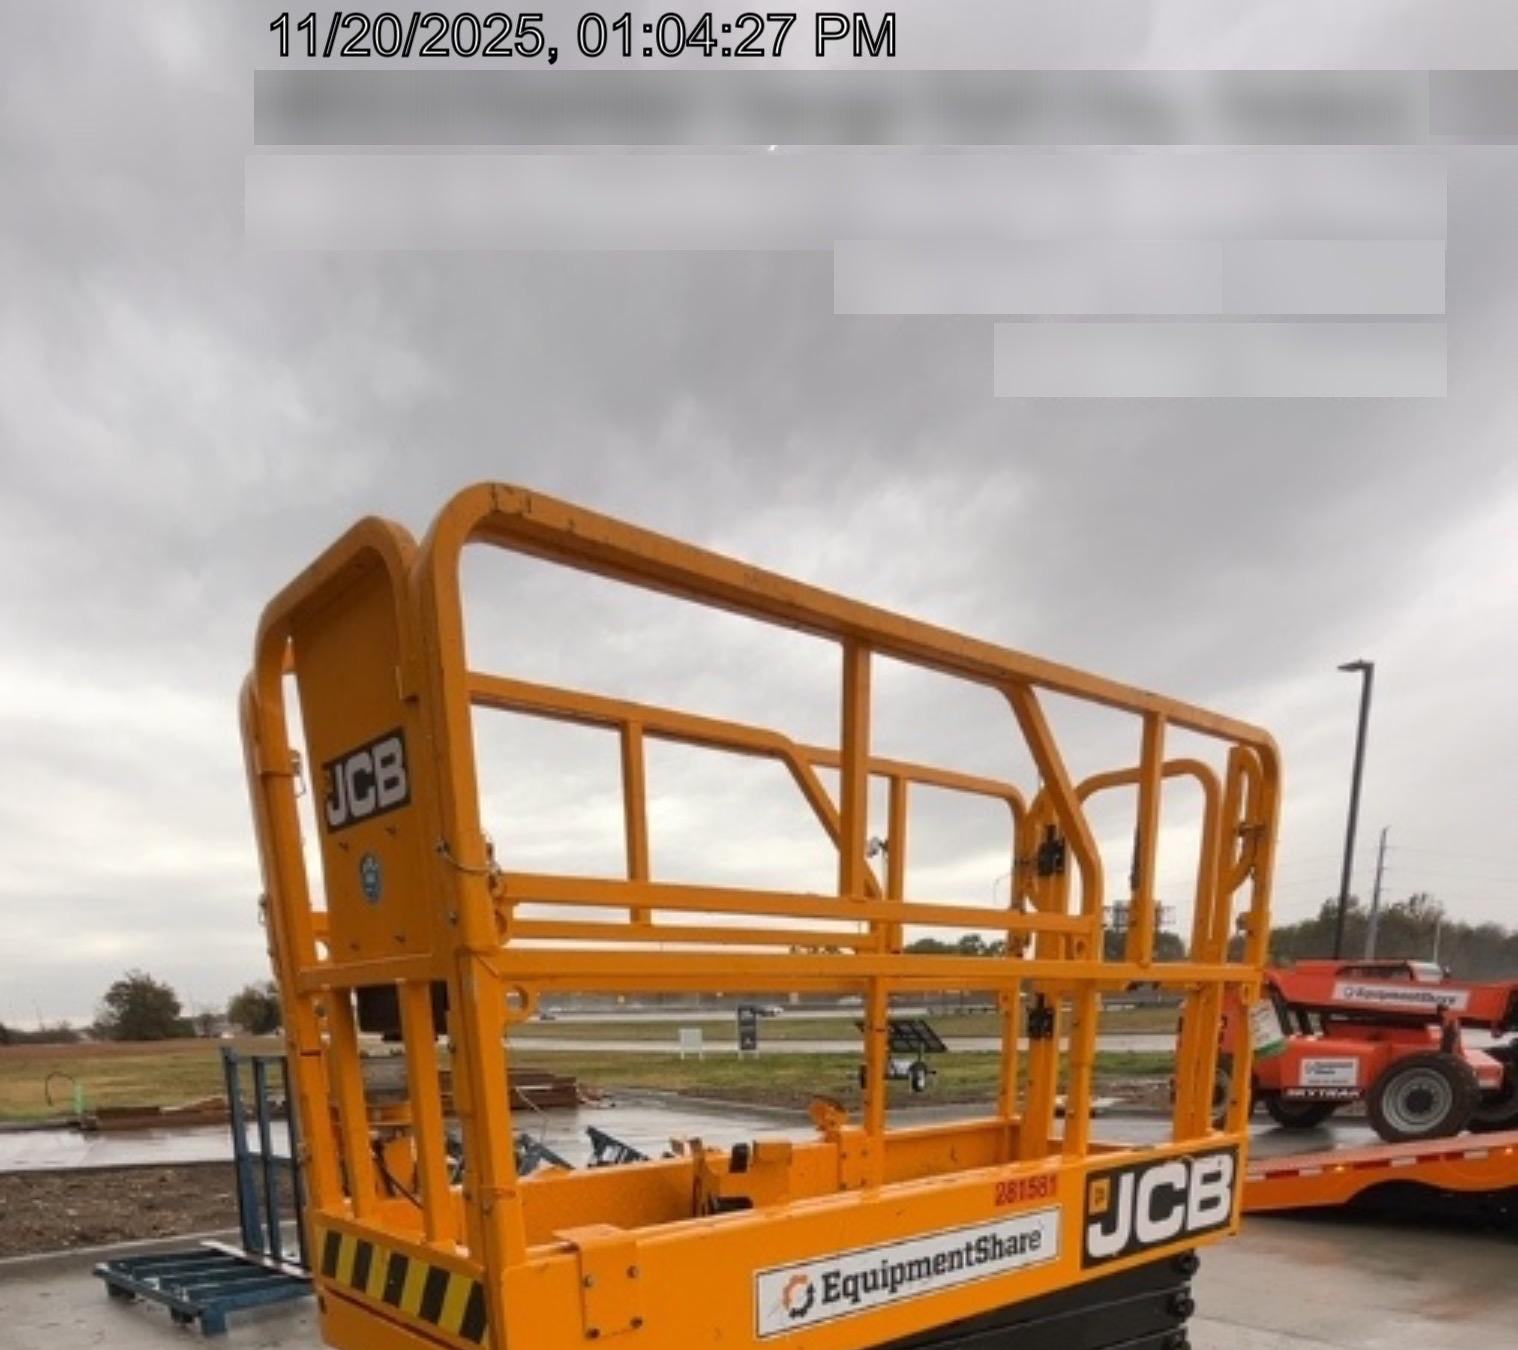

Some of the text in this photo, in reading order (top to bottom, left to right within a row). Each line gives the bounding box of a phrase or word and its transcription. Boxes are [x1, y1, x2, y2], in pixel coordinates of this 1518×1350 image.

[327, 736, 406, 826] JCB
[995, 1174, 1057, 1206] 281581
[1088, 1153, 1234, 1258] JCB
[821, 1229, 1042, 1304] EquipmentShare
